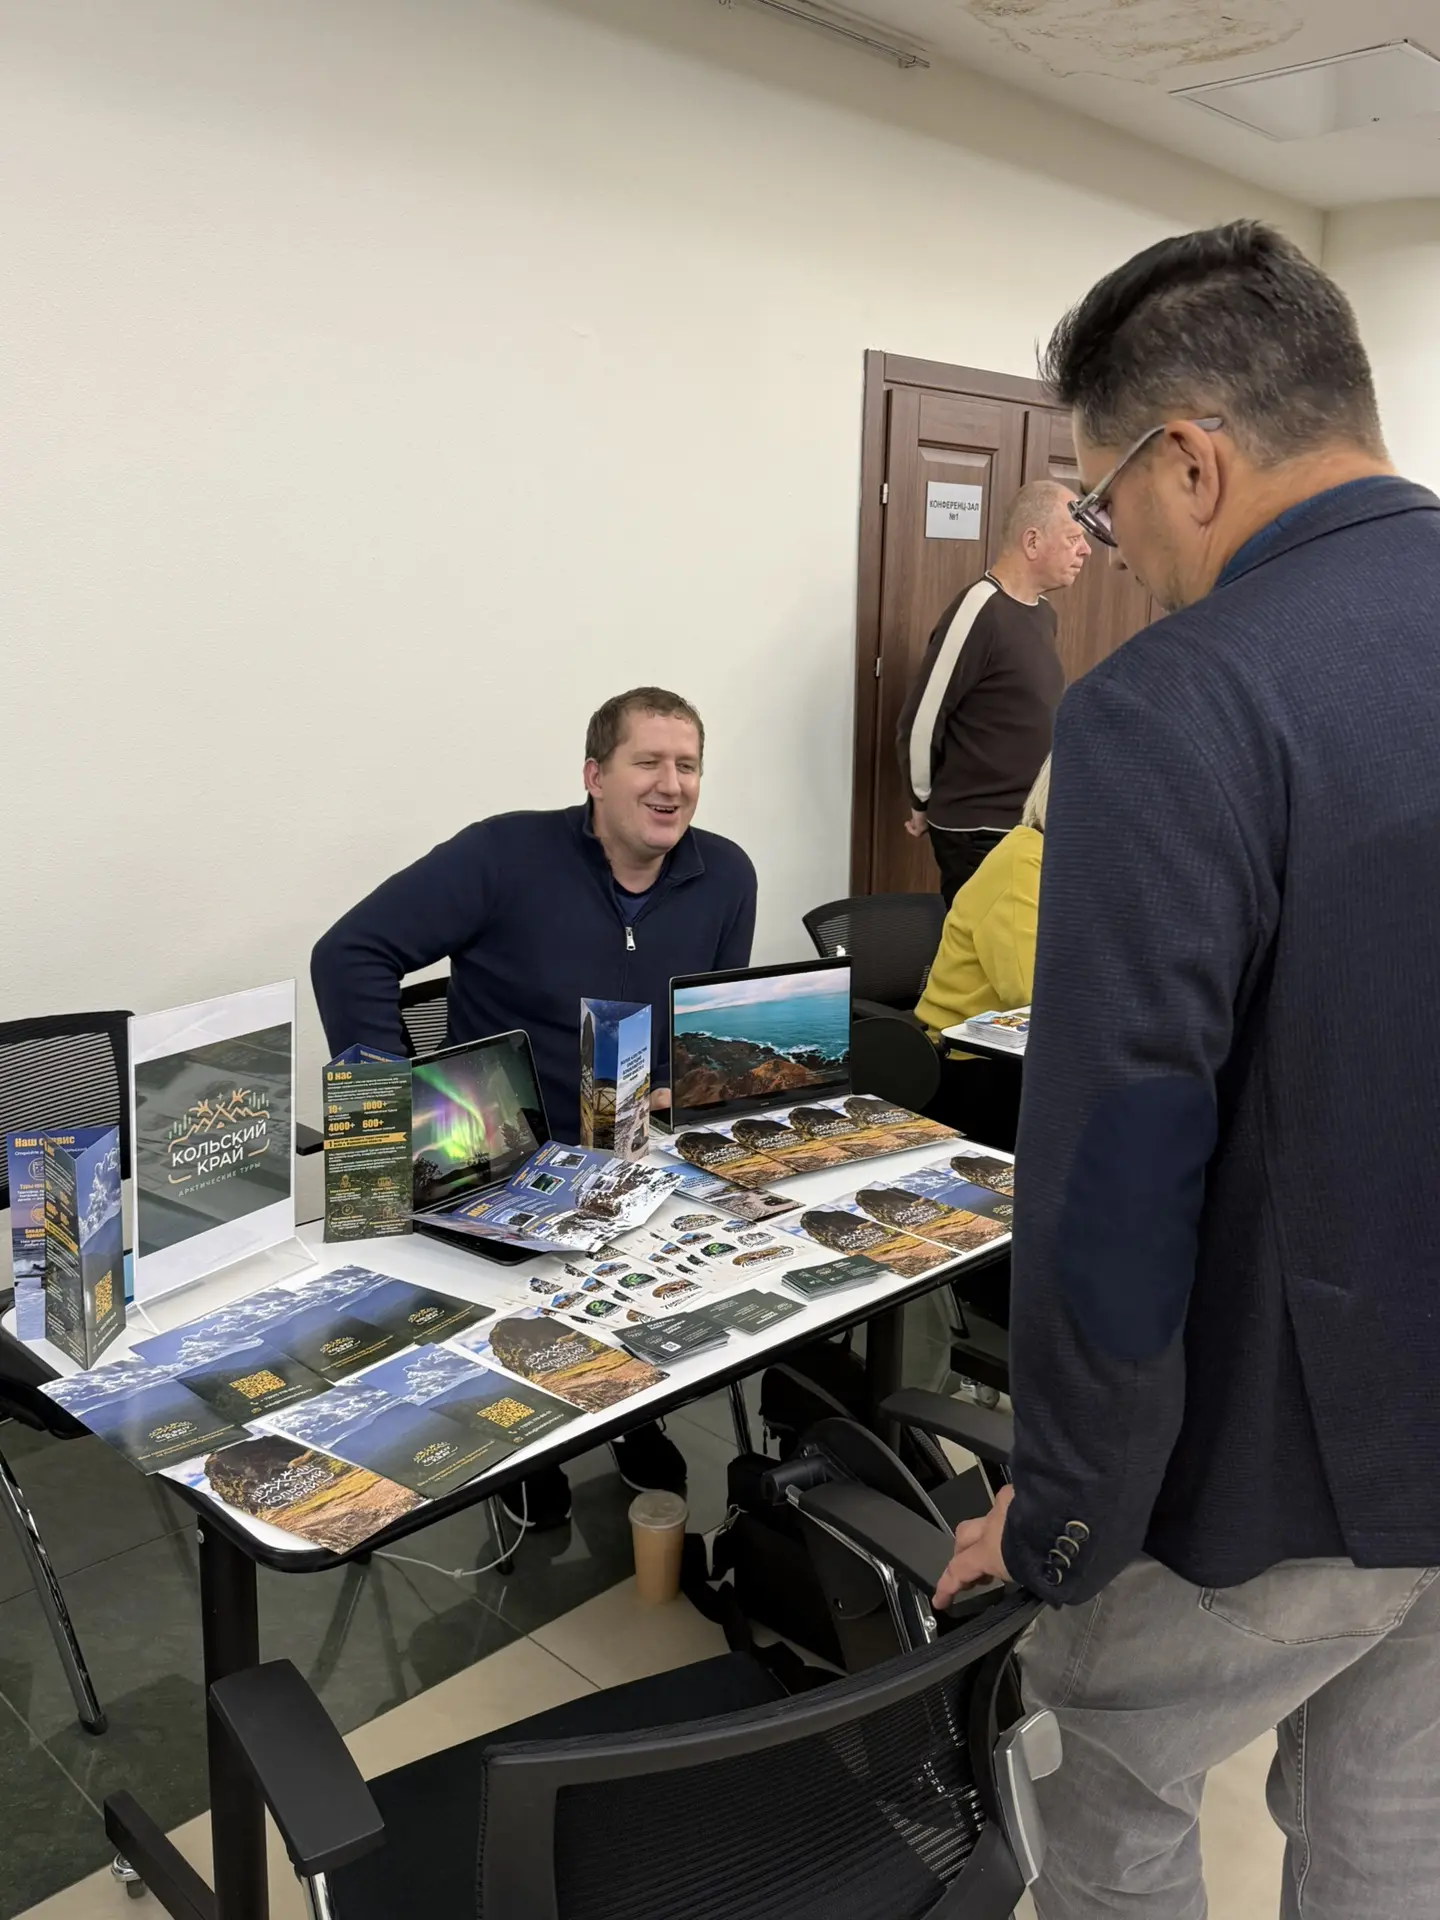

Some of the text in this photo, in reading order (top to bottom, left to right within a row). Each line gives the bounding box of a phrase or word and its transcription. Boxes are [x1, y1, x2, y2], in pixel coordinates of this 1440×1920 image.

[929, 500, 979, 511] КОНФЕРЕНЦ-ЗАЛ
[326, 1071, 353, 1082] О нас
[328, 1100, 388, 1114] 10+ 1000+
[328, 1121, 356, 1132] 4000+
[362, 1118, 385, 1128] 600+
[14, 1138, 37, 1148] Наш
[172, 1119, 267, 1168] КОЛЬСКИЙ
[197, 1144, 244, 1176] КРАЙ
[178, 1162, 261, 1197] АРКТИЧЕСКИЕ ТУРЫ
[264, 1469, 327, 1506] КОЛЬСКИЙ
